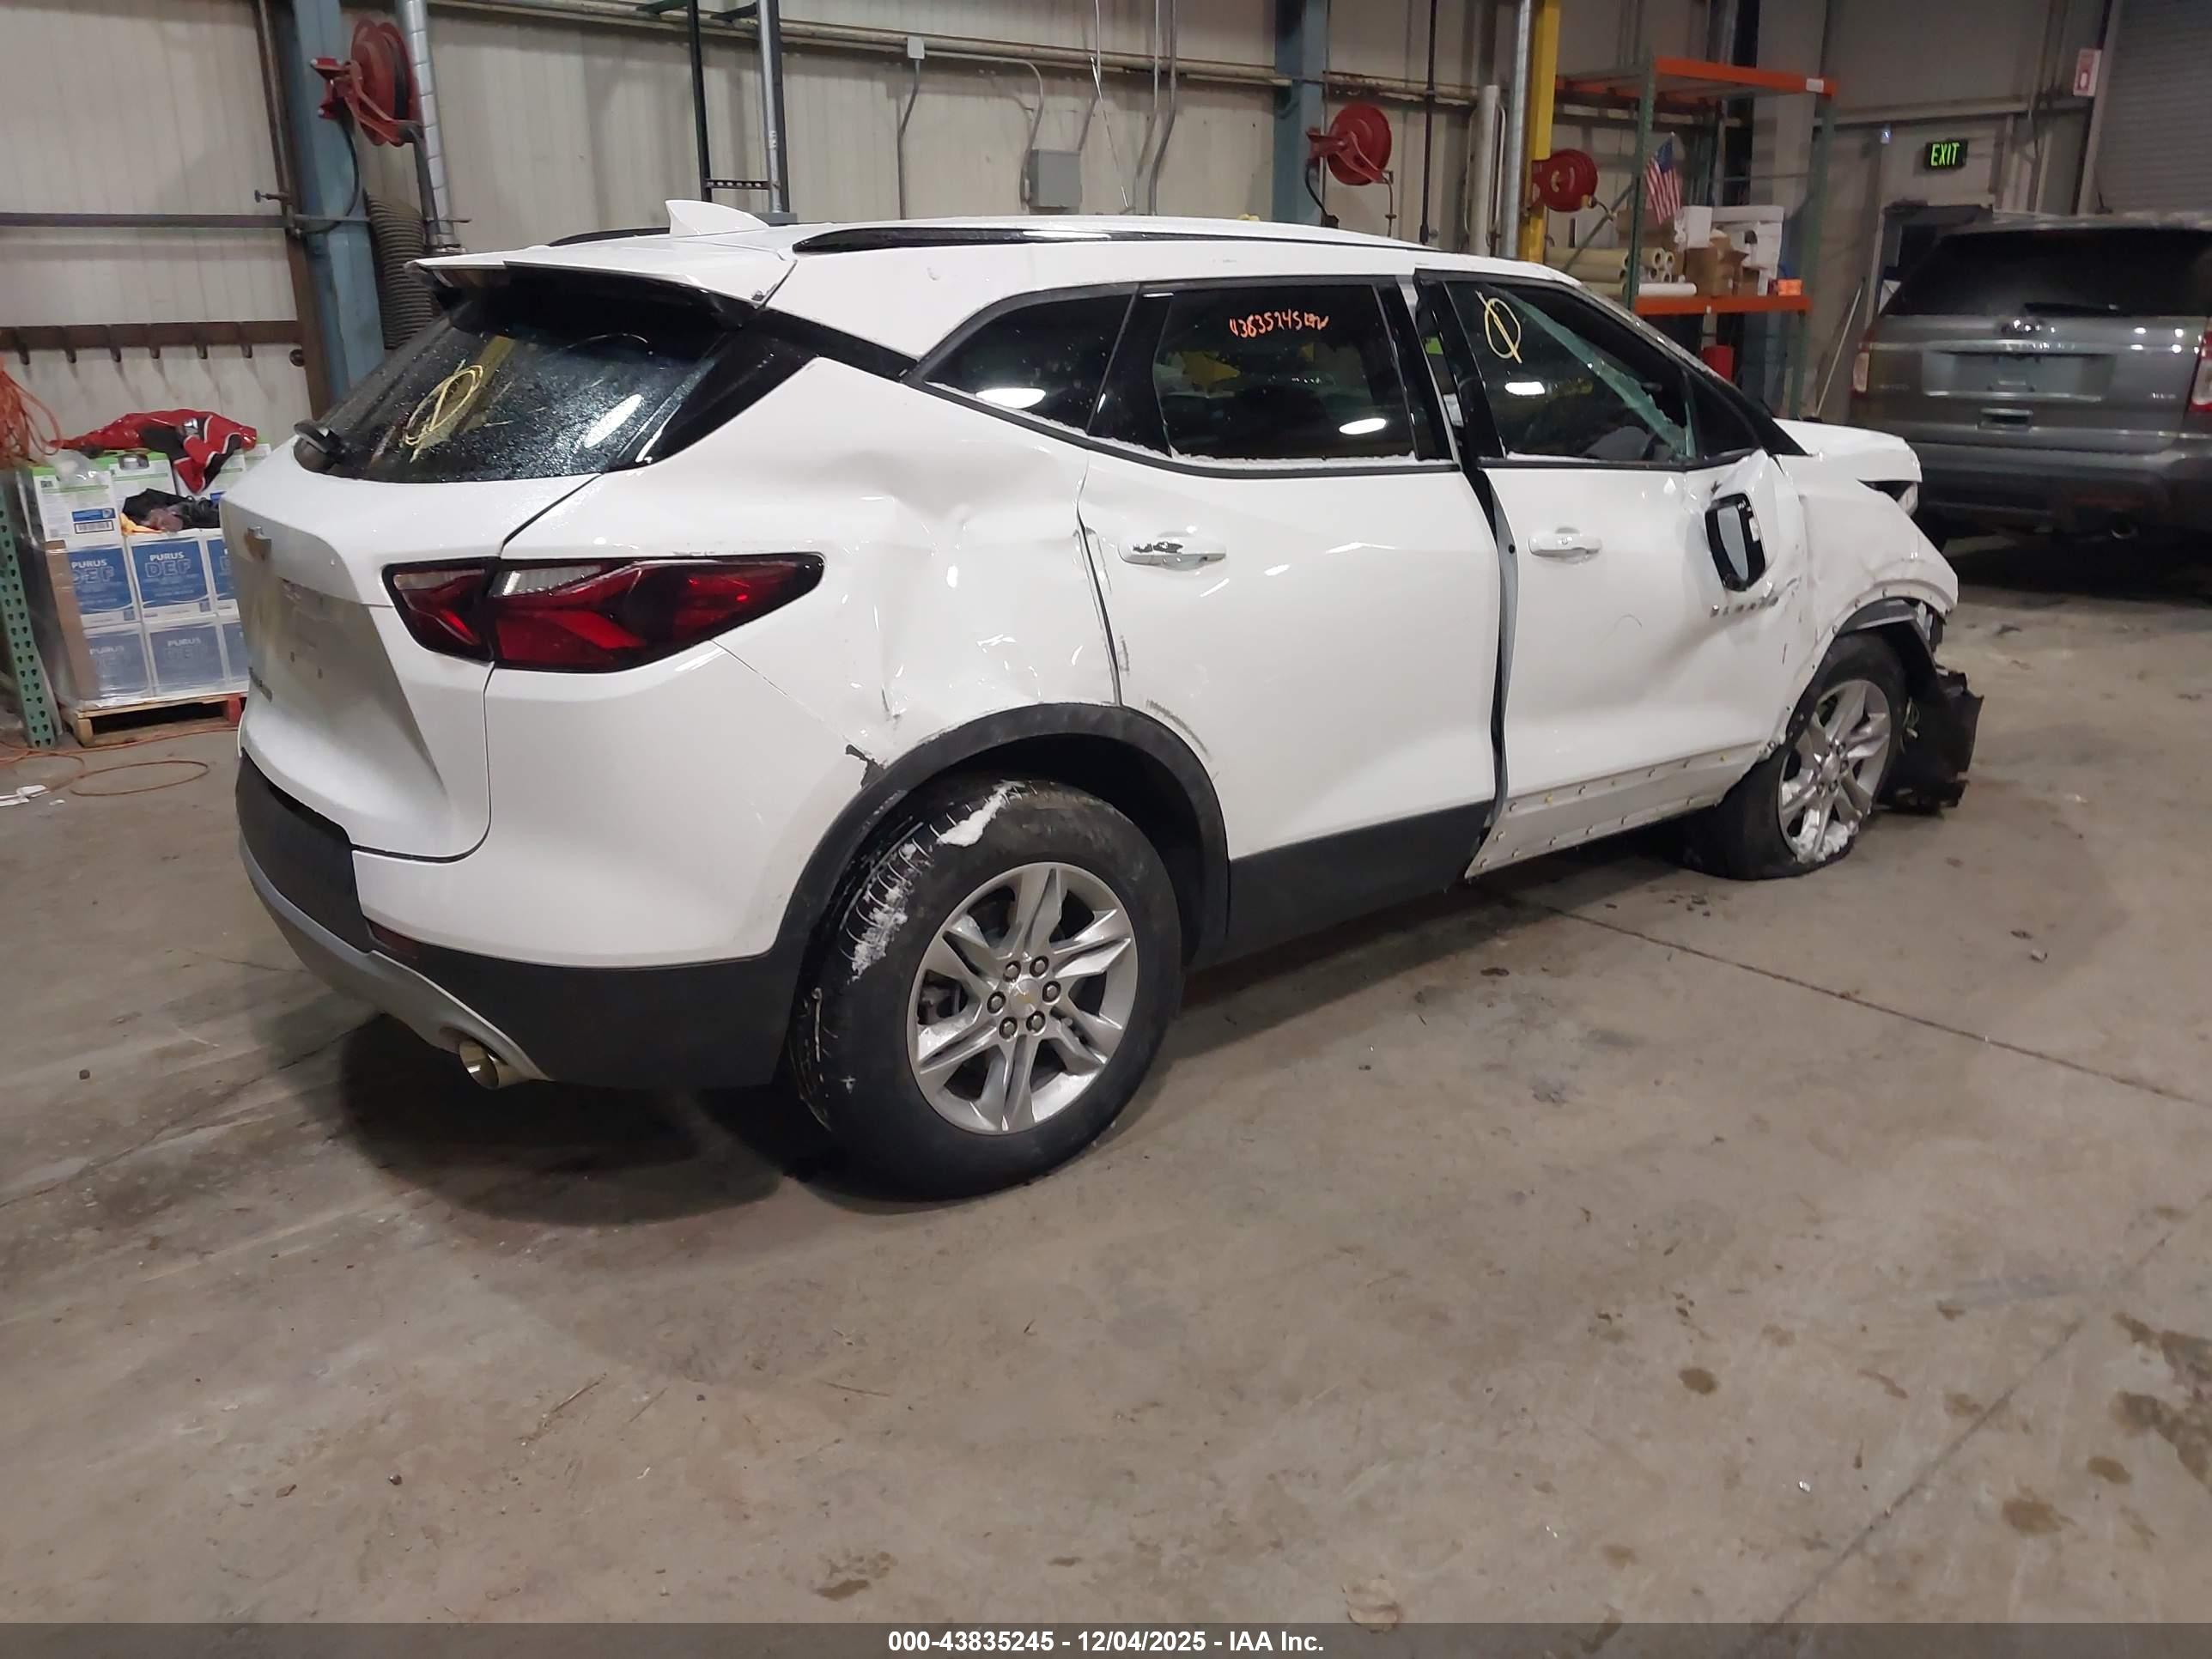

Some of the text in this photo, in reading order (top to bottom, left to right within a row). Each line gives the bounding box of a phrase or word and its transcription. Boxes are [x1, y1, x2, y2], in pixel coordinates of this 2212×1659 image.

[1930, 142, 1960, 166] EXIT
[71, 559, 107, 569] PURUS
[149, 551, 185, 562] PURUS
[144, 558, 192, 578] DEF
